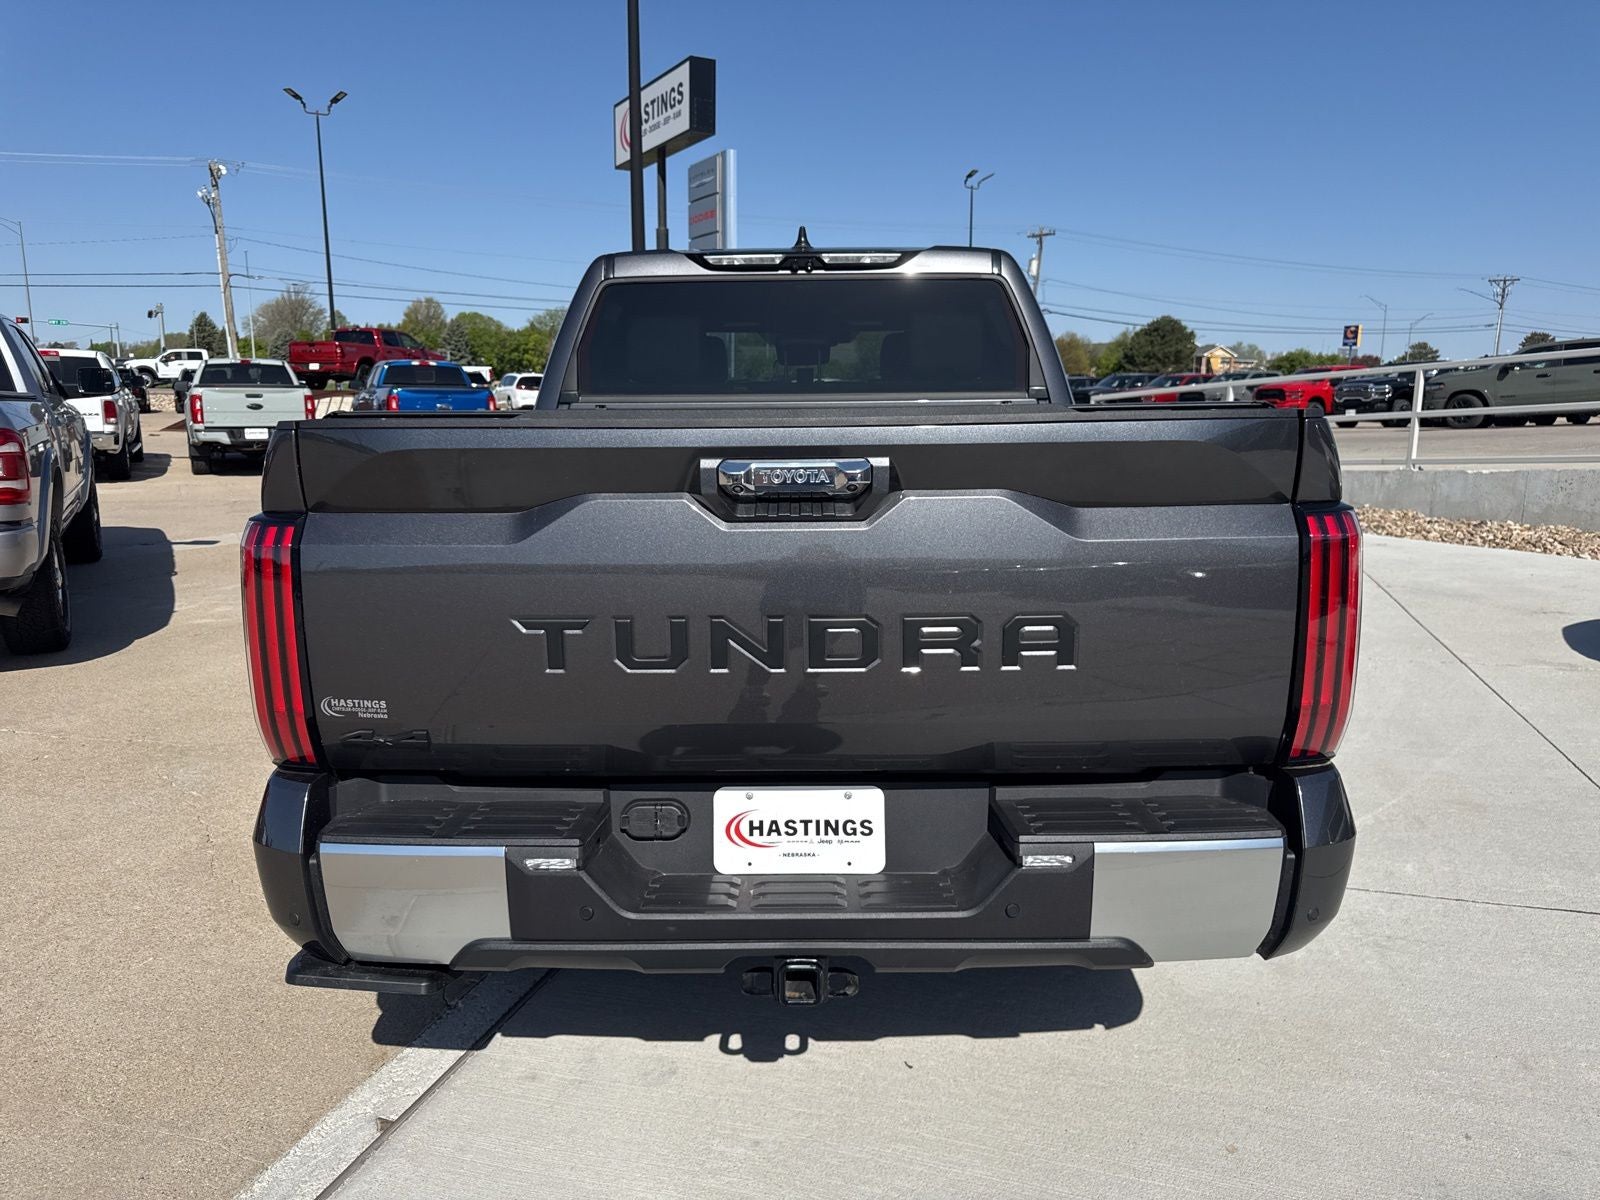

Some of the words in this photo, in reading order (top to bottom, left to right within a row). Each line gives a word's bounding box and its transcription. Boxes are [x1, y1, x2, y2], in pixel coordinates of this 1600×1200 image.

[641, 81, 684, 126] STINGS
[759, 468, 830, 484] TOYOTA
[510, 612, 1079, 675] TUNDRA
[331, 698, 387, 709] HASTINGS
[748, 819, 874, 837] HASTINGS
